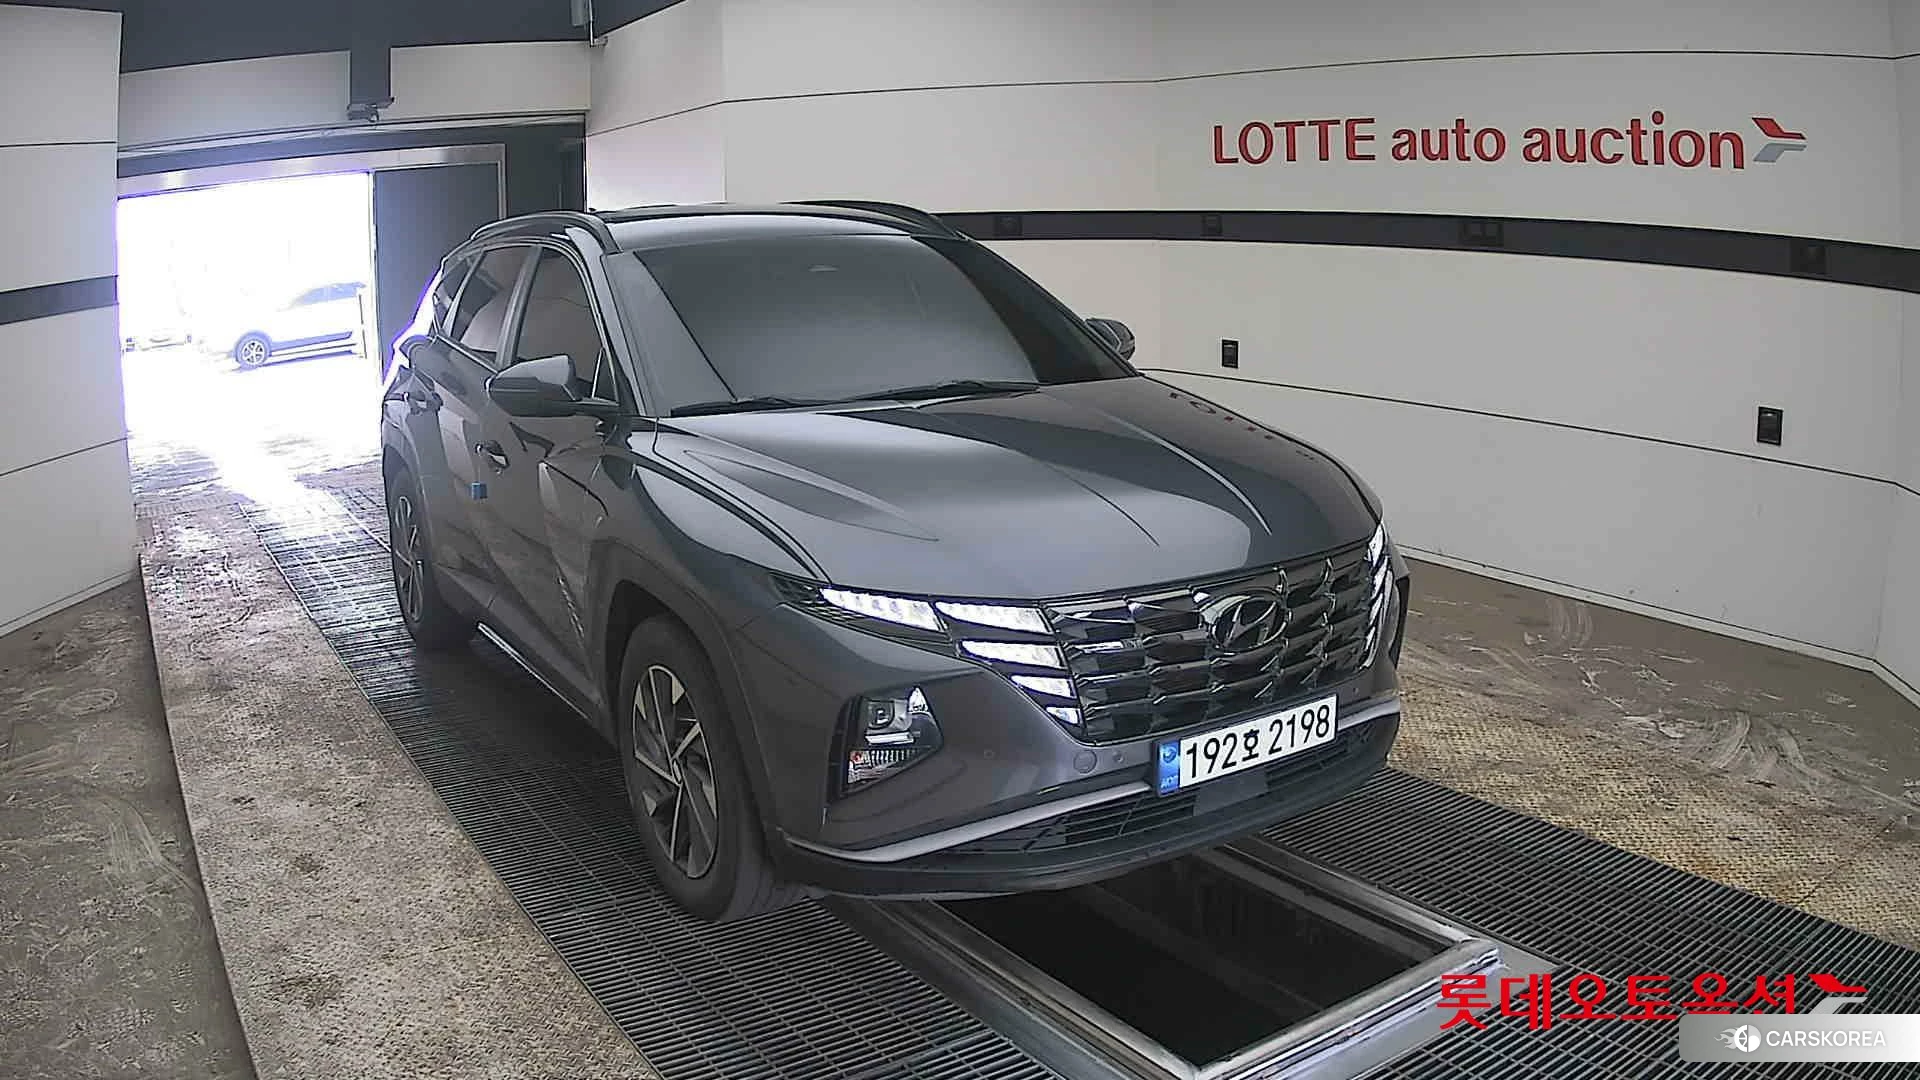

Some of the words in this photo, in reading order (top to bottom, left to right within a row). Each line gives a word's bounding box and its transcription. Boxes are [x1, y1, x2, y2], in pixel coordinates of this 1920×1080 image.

[1213, 118, 1377, 165] LOTTE
[1391, 118, 1507, 162] auto
[1522, 111, 1745, 168] auction
[1186, 728, 1260, 779] 192호
[1268, 704, 1330, 756] 2198
